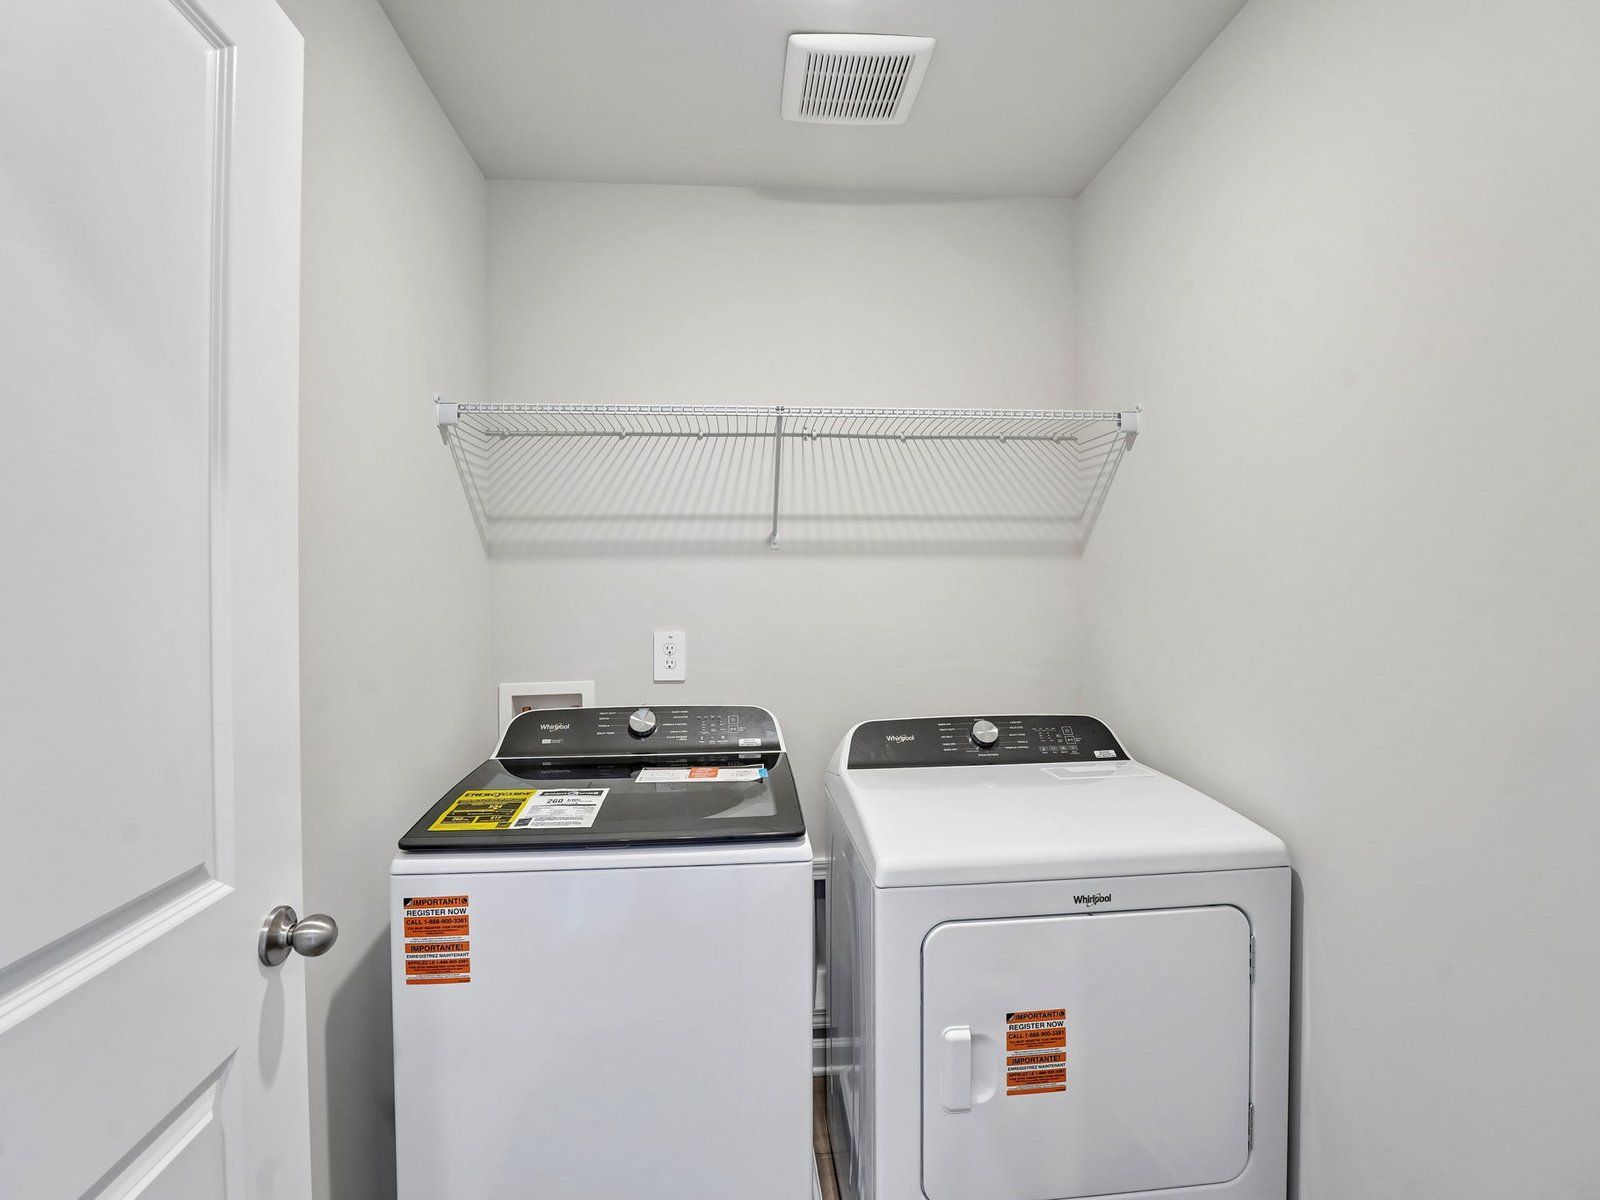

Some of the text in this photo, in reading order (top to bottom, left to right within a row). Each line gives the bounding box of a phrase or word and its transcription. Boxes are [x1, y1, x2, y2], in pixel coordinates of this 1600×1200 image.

[540, 722, 570, 733] Whirlpool
[886, 735, 914, 744] Whirlpool
[413, 898, 461, 907] IMPORTANT!
[1073, 893, 1112, 907] Whirlpool
[406, 909, 446, 917] REGISTER
[410, 944, 463, 952] IMPORTANTE!
[1014, 1011, 1060, 1020] IMPORTANT!
[1008, 1022, 1045, 1031] REGISTER
[1012, 1055, 1061, 1064] IMPORTANTE!
